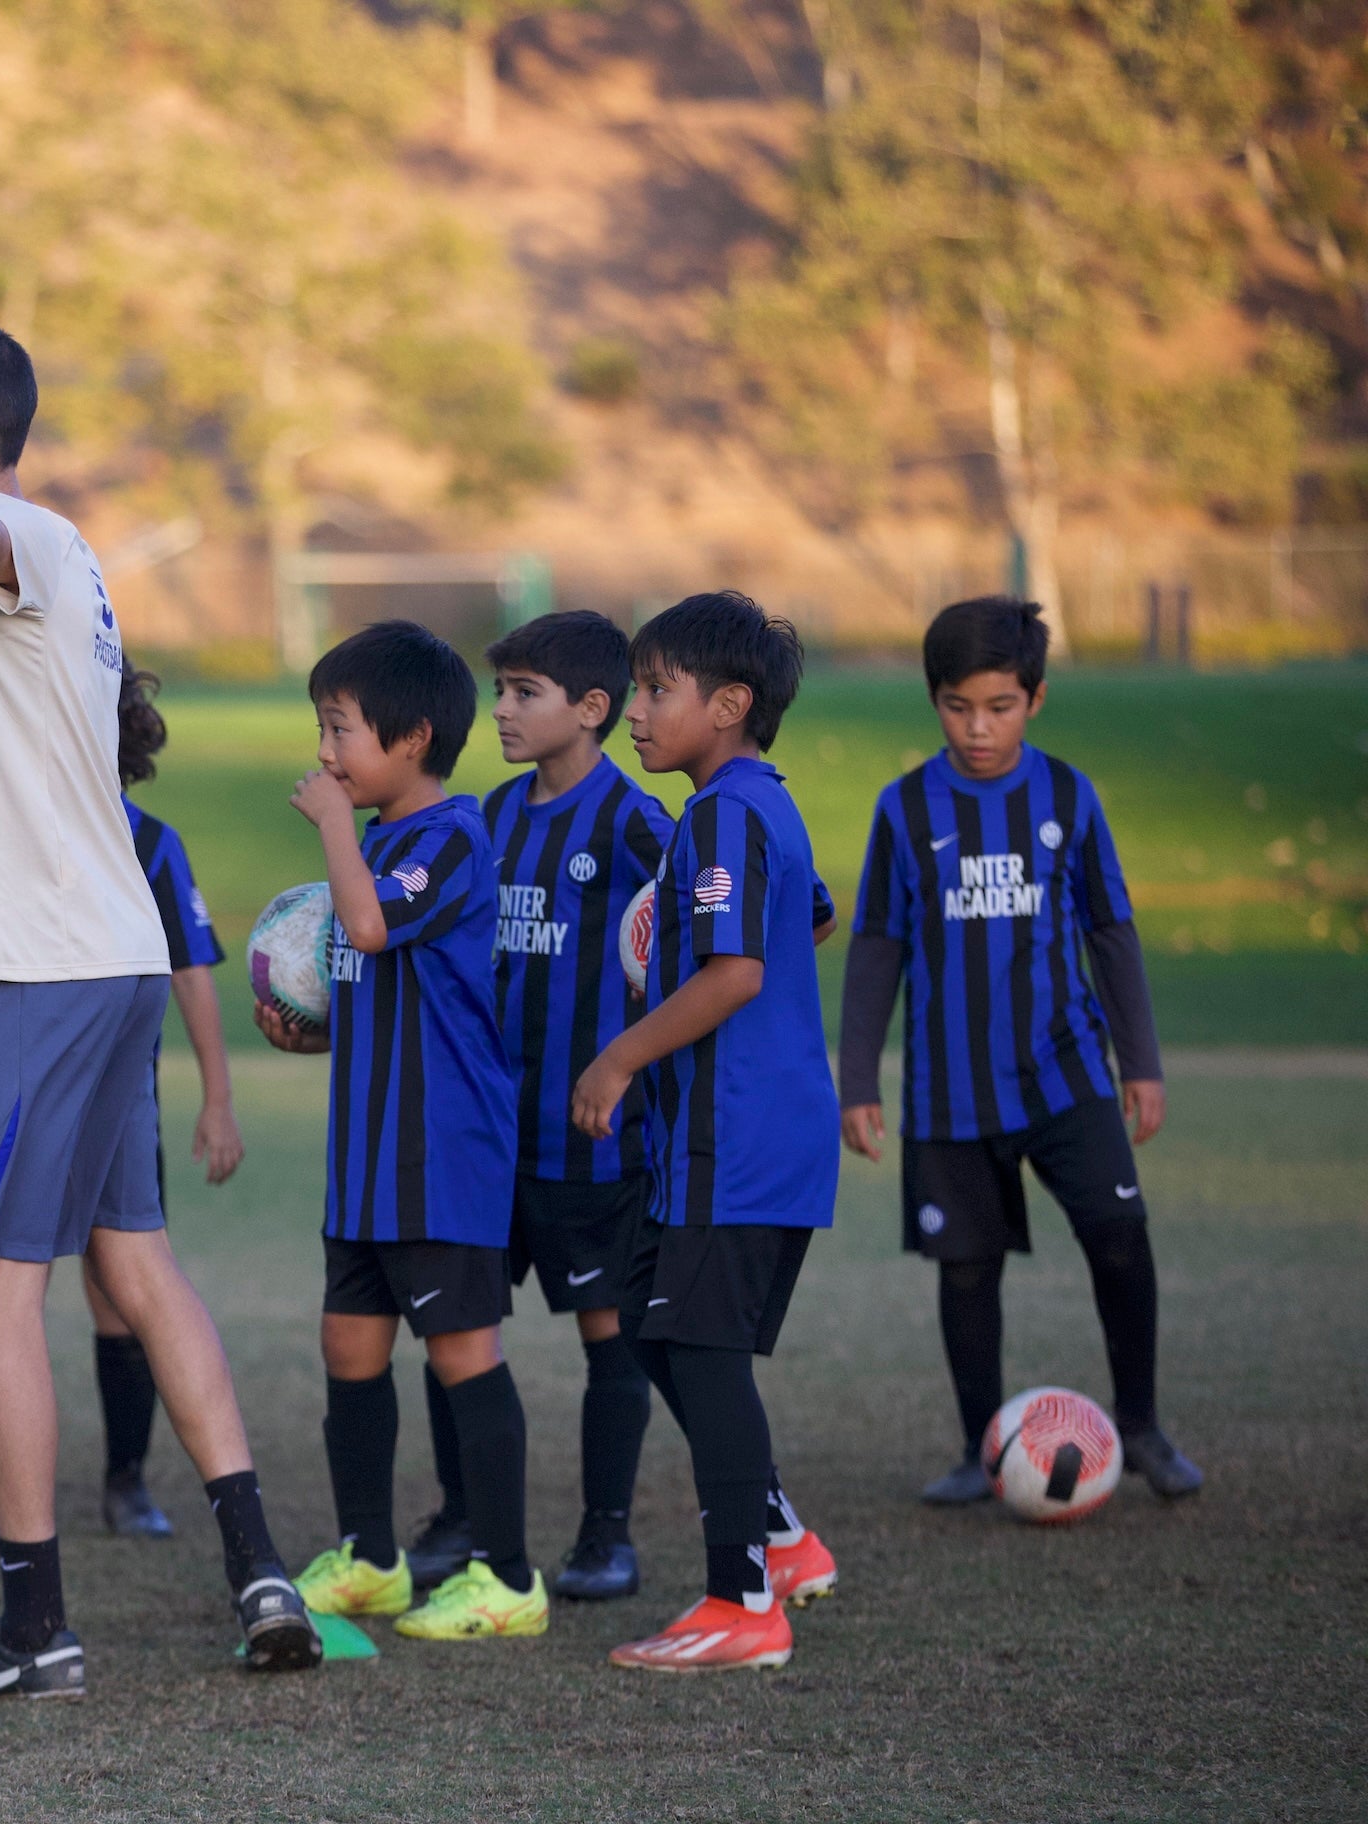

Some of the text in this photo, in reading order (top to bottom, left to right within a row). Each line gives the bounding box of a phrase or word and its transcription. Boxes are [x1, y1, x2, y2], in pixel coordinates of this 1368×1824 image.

[959, 853, 1025, 888] INTER
[694, 903, 731, 915] ROCKERS
[944, 883, 1044, 921] ACADEMY
